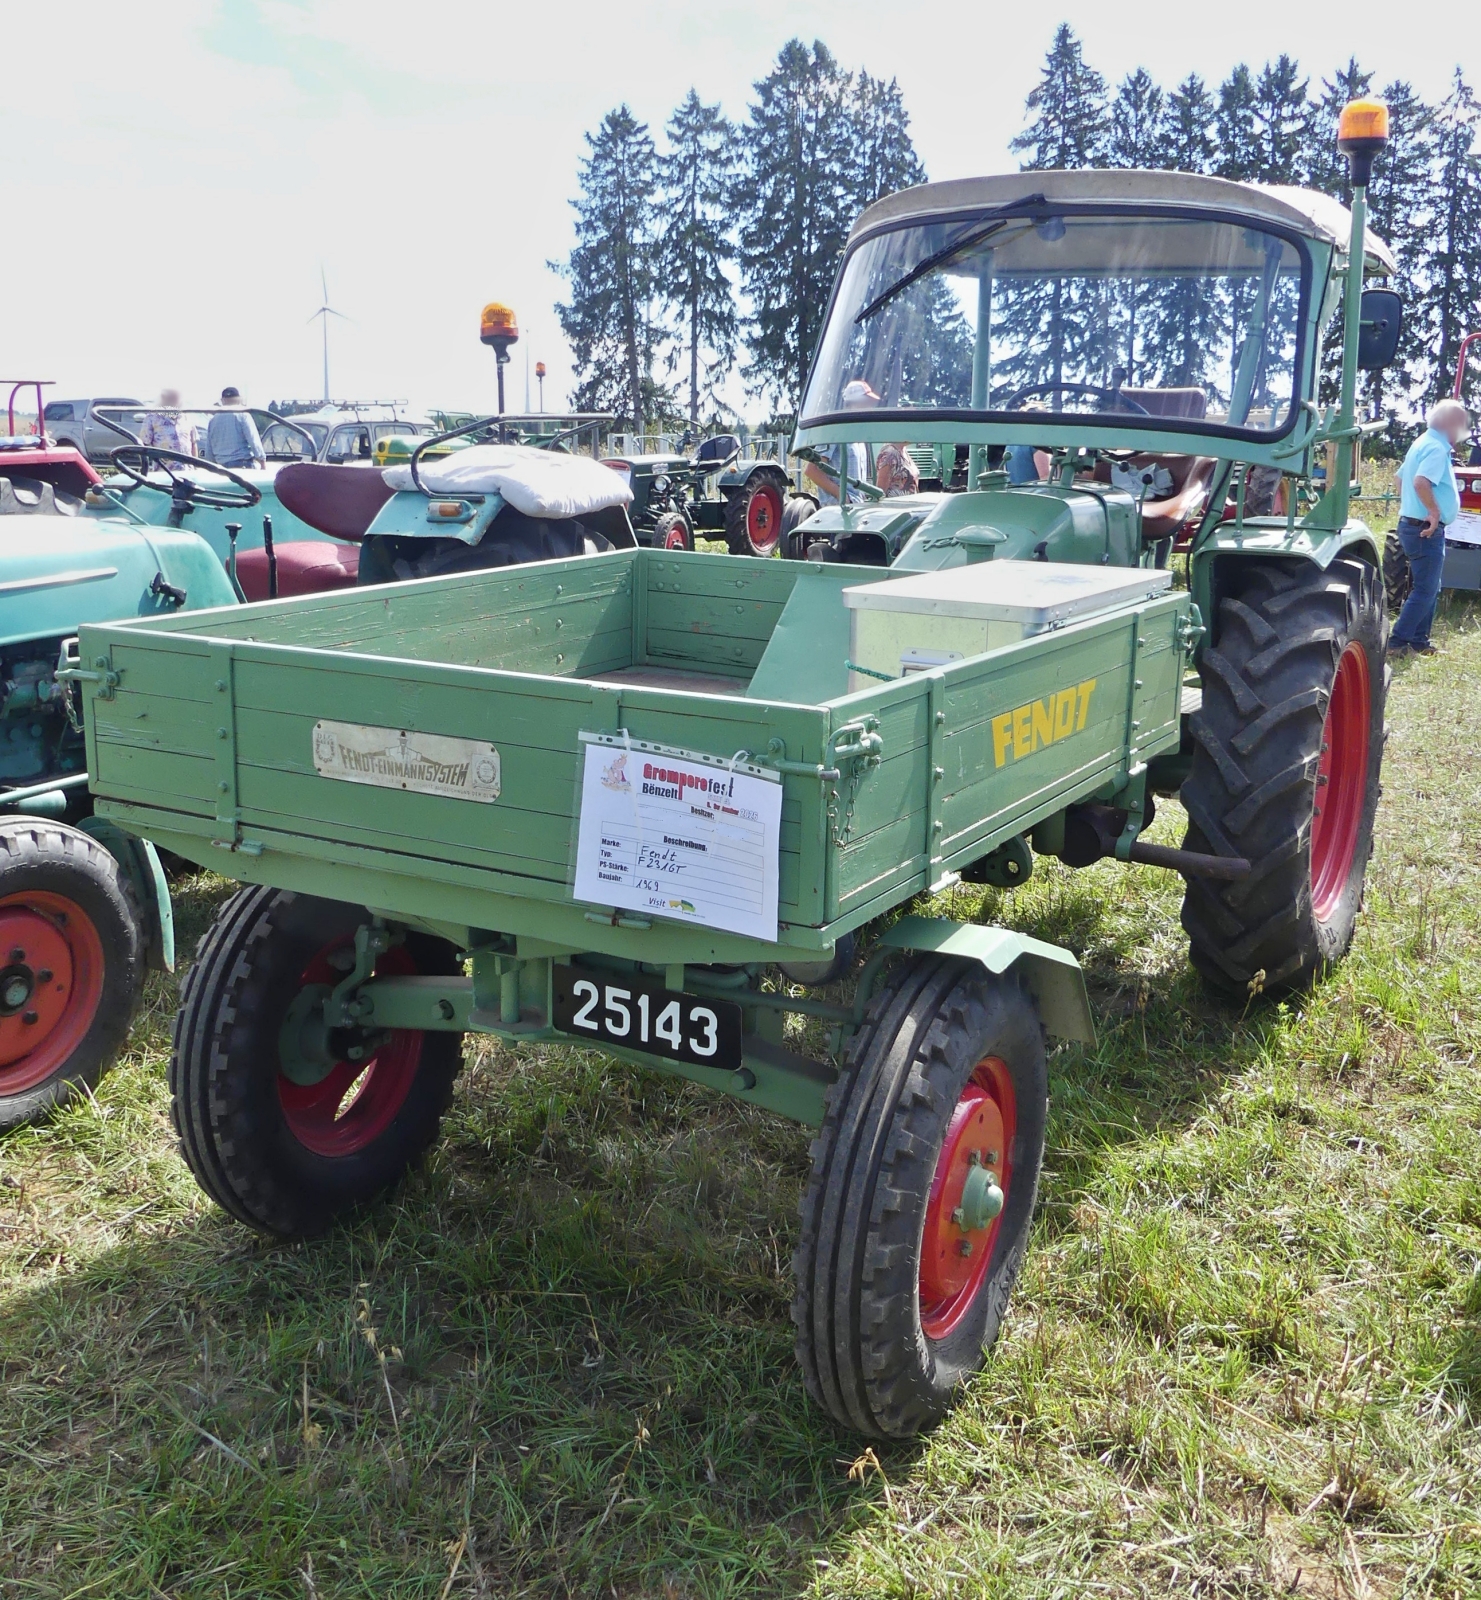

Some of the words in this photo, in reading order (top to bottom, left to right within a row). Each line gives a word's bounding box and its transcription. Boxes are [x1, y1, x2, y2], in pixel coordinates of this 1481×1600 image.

[992, 679, 1097, 768] FENDT
[643, 763, 734, 800] Gromperefest
[642, 782, 678, 800] Bënzelt
[690, 805, 715, 820] Besitzer:
[601, 838, 622, 848] Marke:
[663, 835, 708, 852] Beschreibung:
[641, 845, 677, 862] Fendt
[599, 860, 629, 873] PS-Stärke:
[598, 871, 623, 883] Baujahr:
[636, 879, 659, 892] 1969
[649, 897, 667, 908] Visit
[573, 979, 718, 1057] 25143
